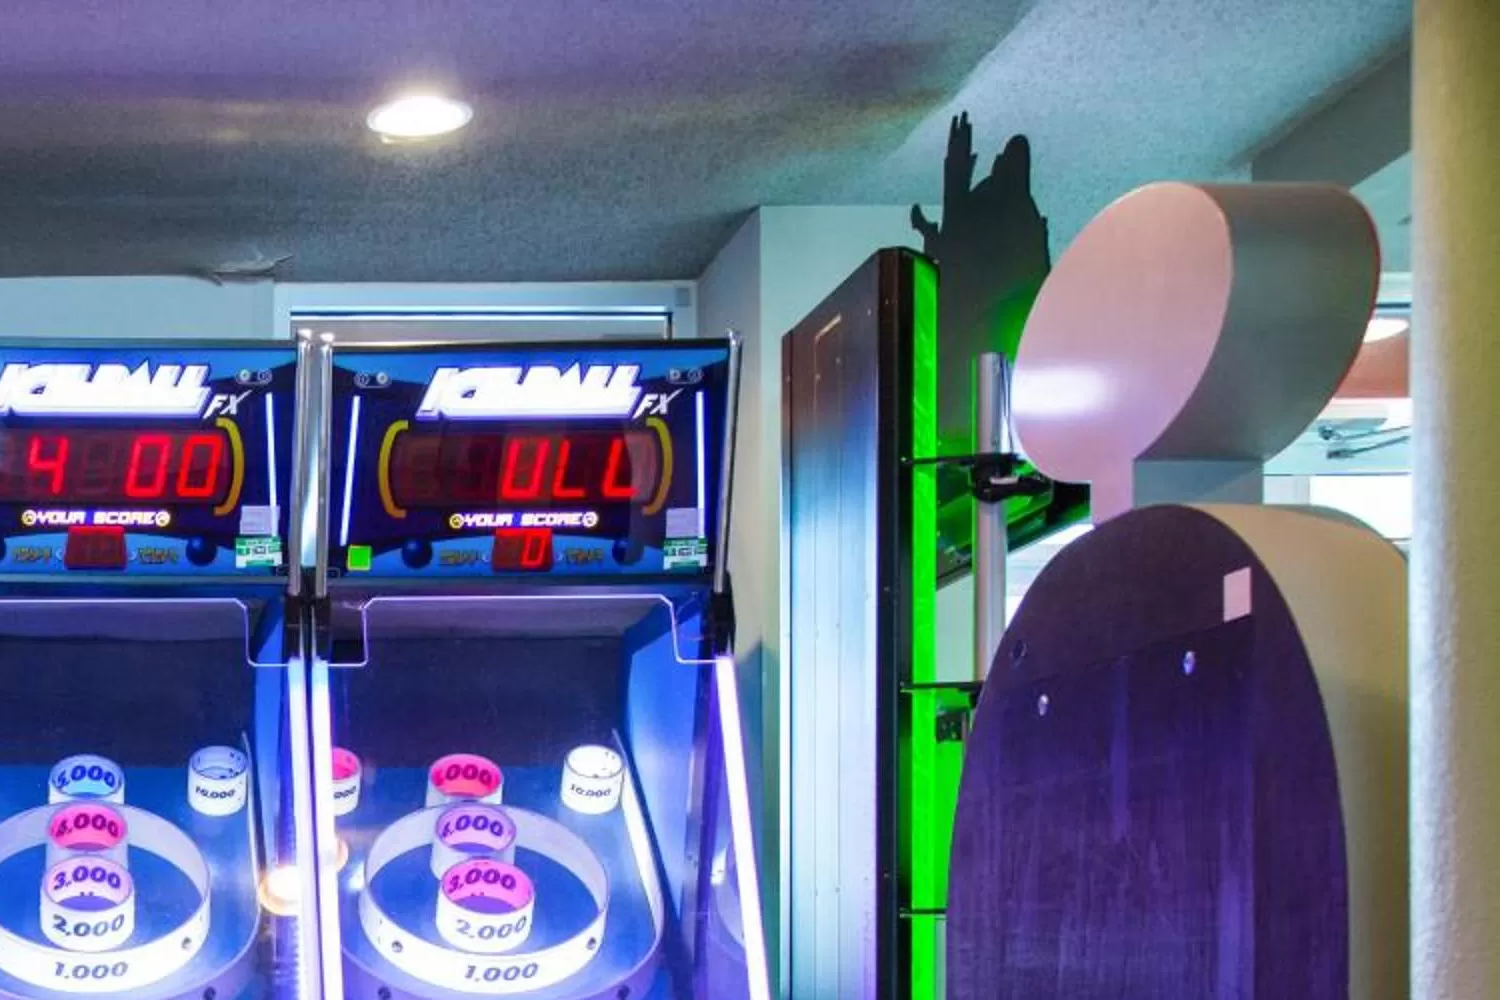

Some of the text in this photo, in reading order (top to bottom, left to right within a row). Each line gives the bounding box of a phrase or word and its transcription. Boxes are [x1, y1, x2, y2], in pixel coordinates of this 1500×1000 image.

[202, 390, 252, 419] FX
[632, 388, 683, 420] FX
[36, 510, 157, 525] YOUR SCORE
[464, 512, 583, 527] YOUR SCORE
